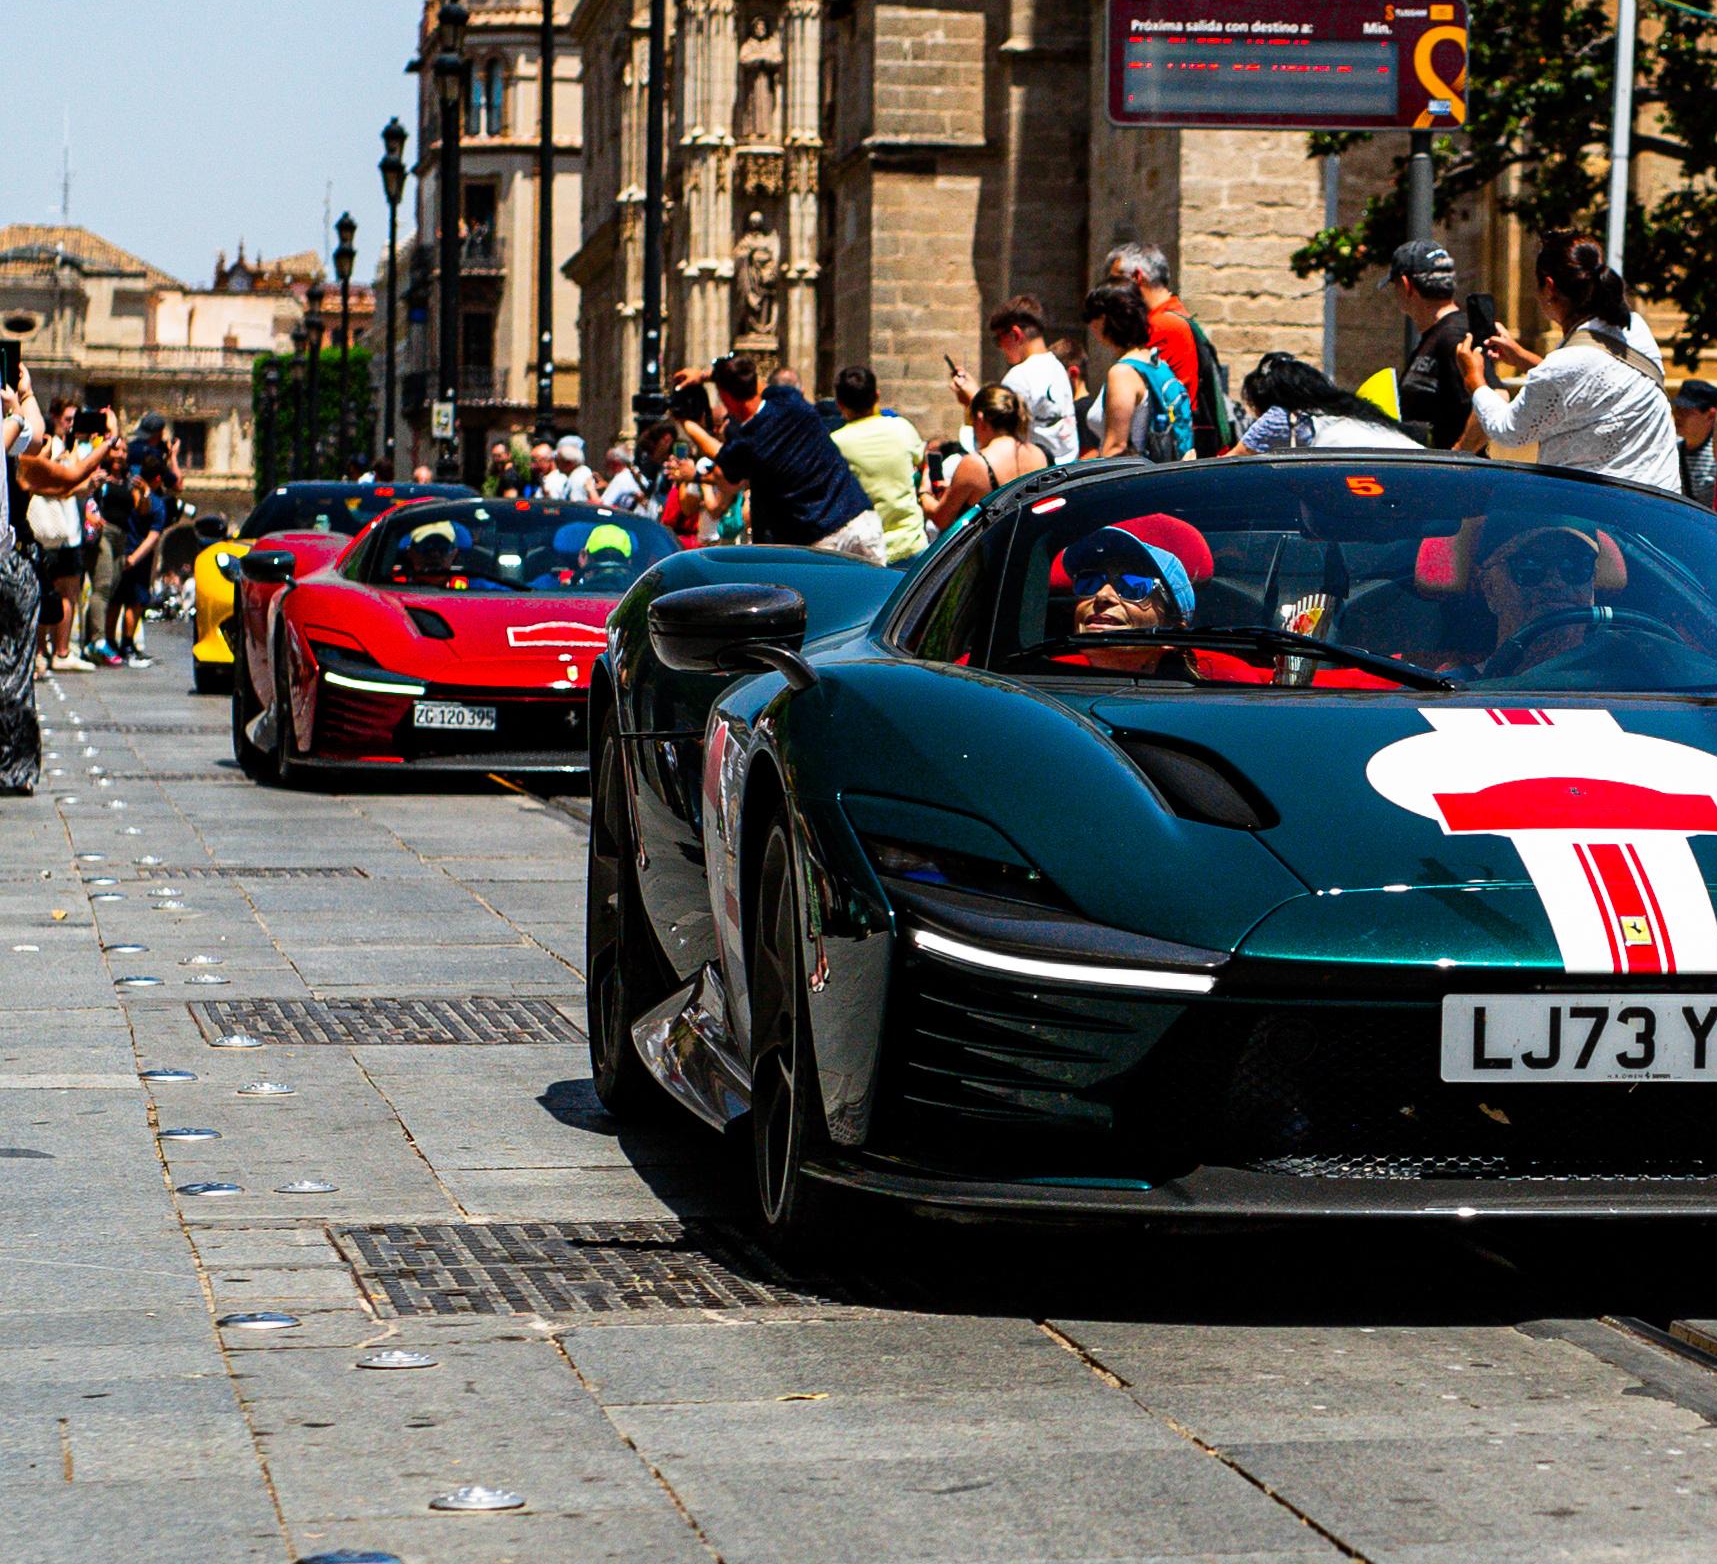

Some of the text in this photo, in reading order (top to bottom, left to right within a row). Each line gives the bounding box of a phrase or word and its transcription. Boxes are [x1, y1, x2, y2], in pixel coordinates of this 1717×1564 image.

[1131, 19, 1183, 32] Próxima
[1186, 20, 1223, 33] salida
[1225, 22, 1249, 33] con
[1251, 20, 1299, 34] destino
[1363, 21, 1393, 35] Min.
[1345, 475, 1385, 497] 5
[440, 709, 465, 725] 120
[467, 707, 495, 727] 395
[1473, 1006, 1656, 1070] LJ73
